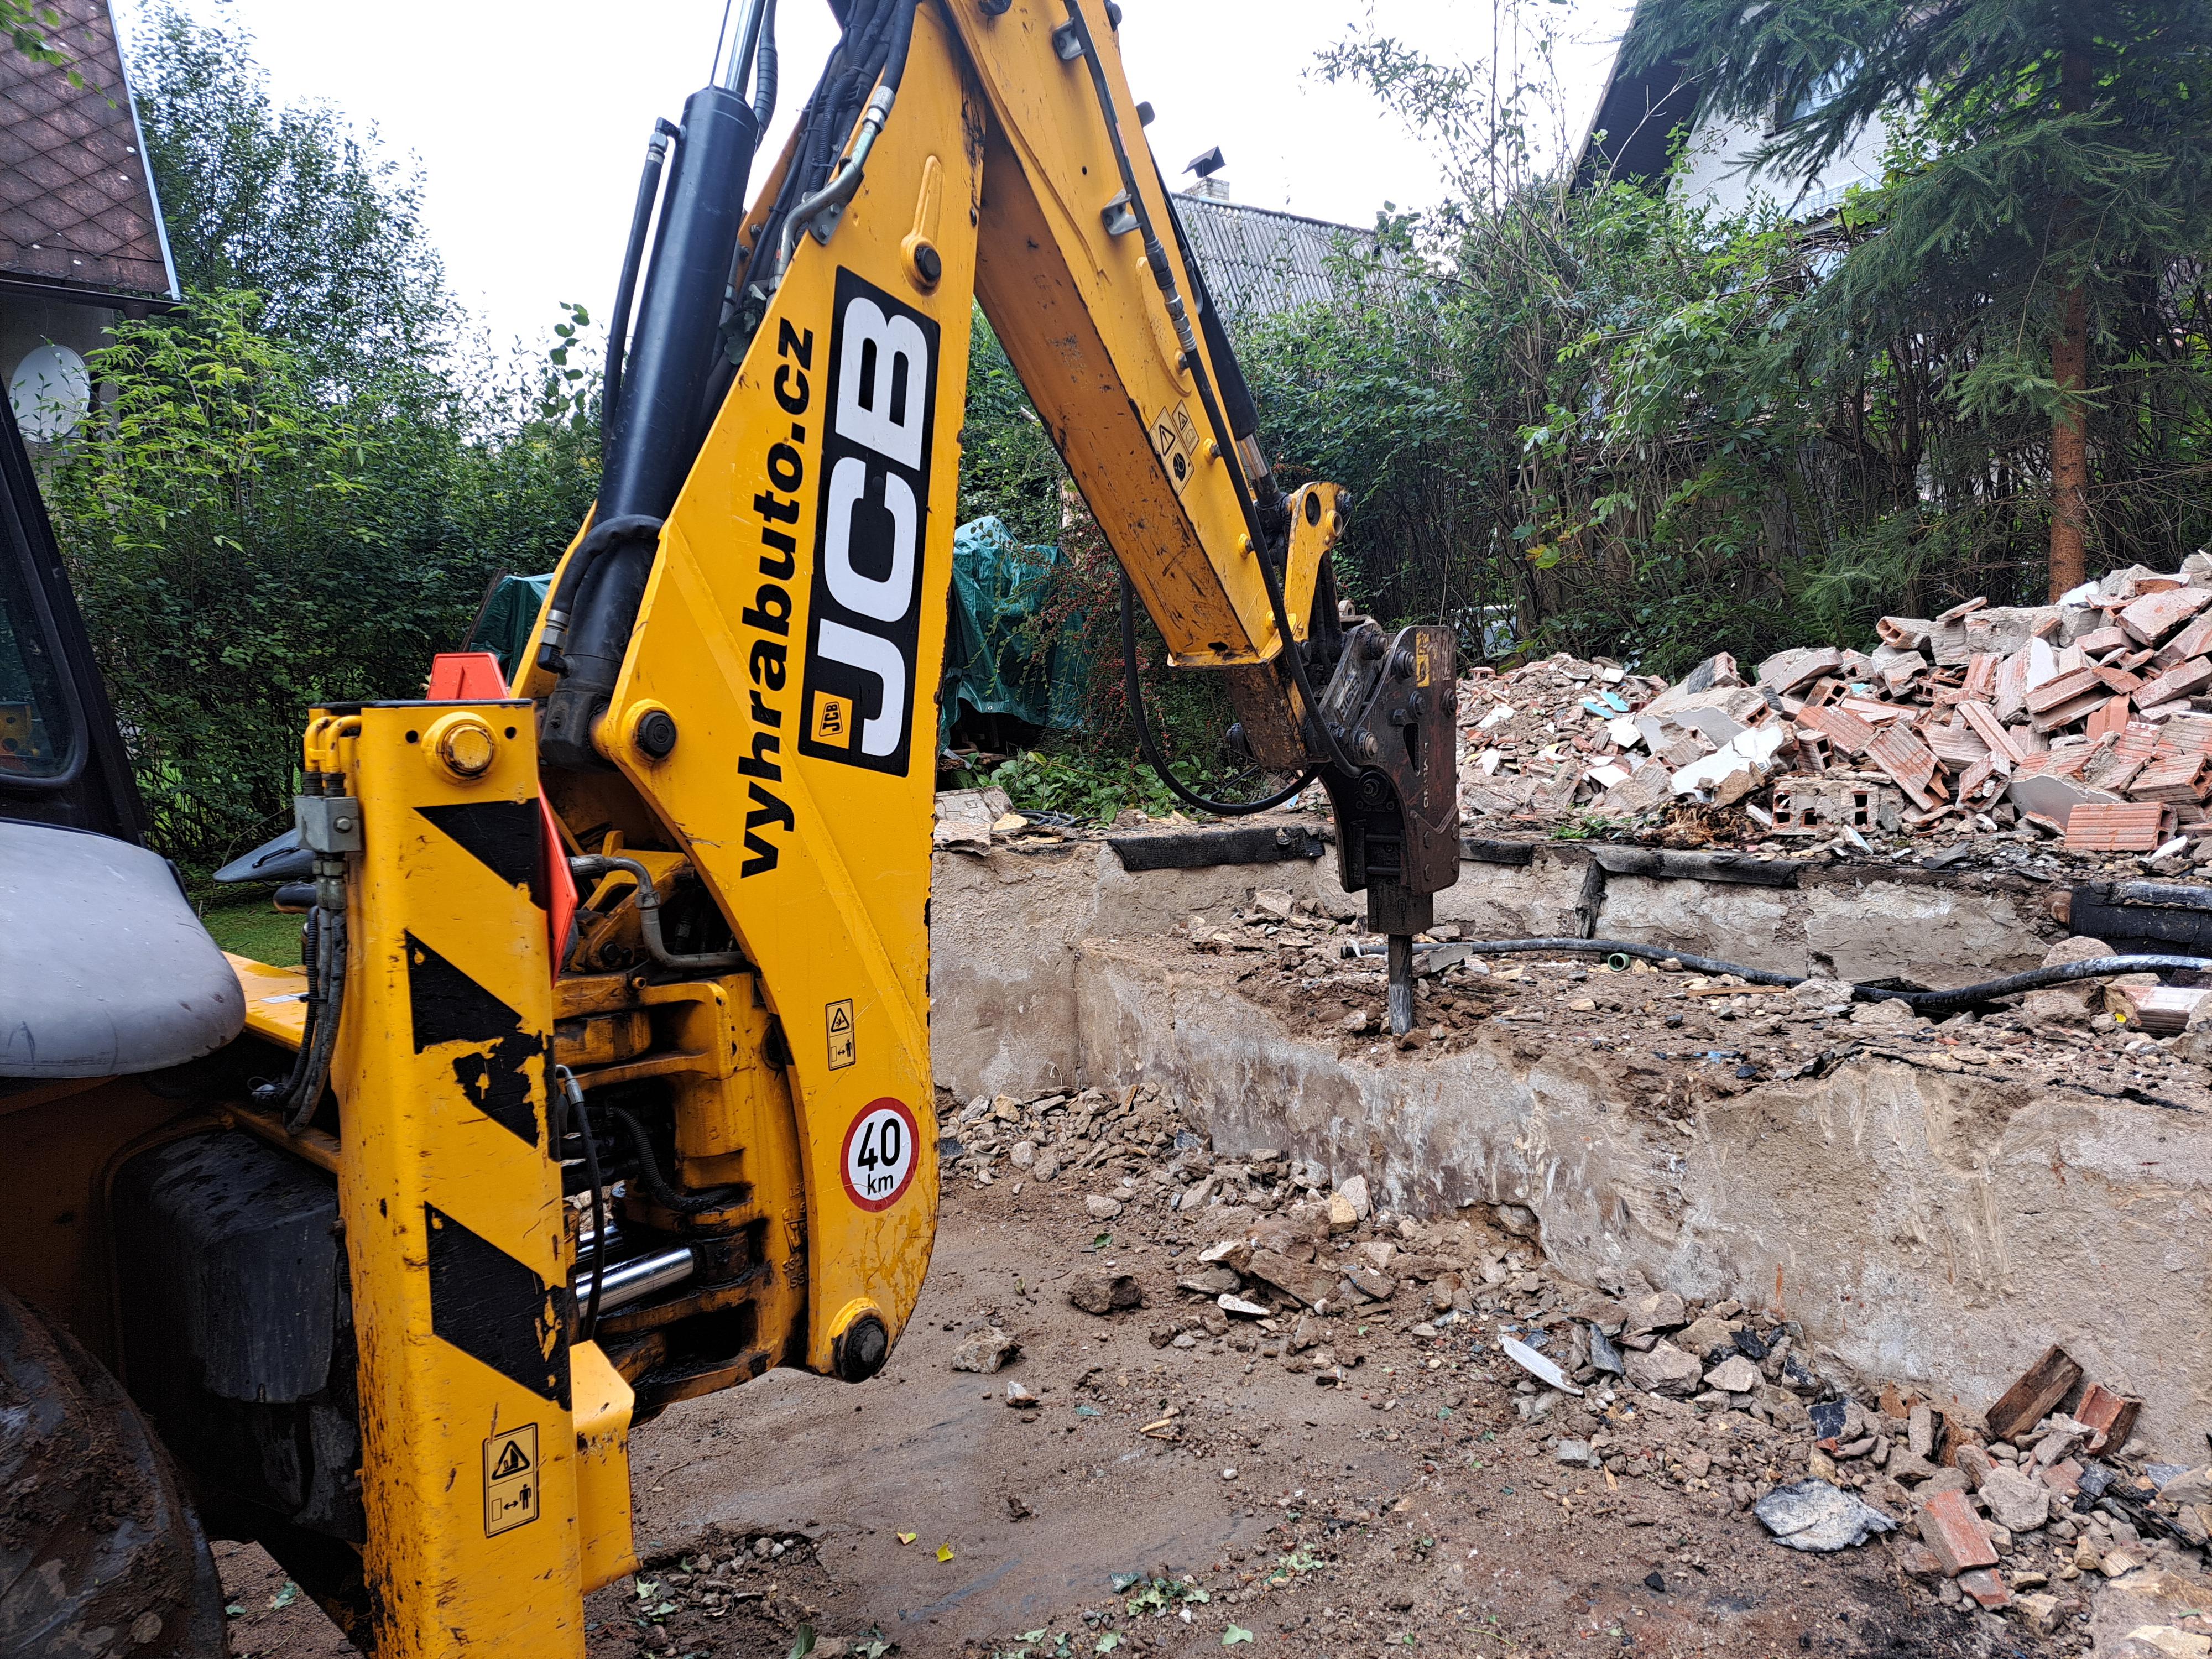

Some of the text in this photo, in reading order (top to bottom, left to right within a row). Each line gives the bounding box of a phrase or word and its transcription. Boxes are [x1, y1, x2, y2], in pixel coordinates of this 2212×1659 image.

[817, 296, 928, 757] JCB
[738, 316, 813, 879] vyhrabuto.cz
[822, 704, 840, 732] JCB
[857, 1118, 900, 1171] 40
[867, 1173, 893, 1196] km
